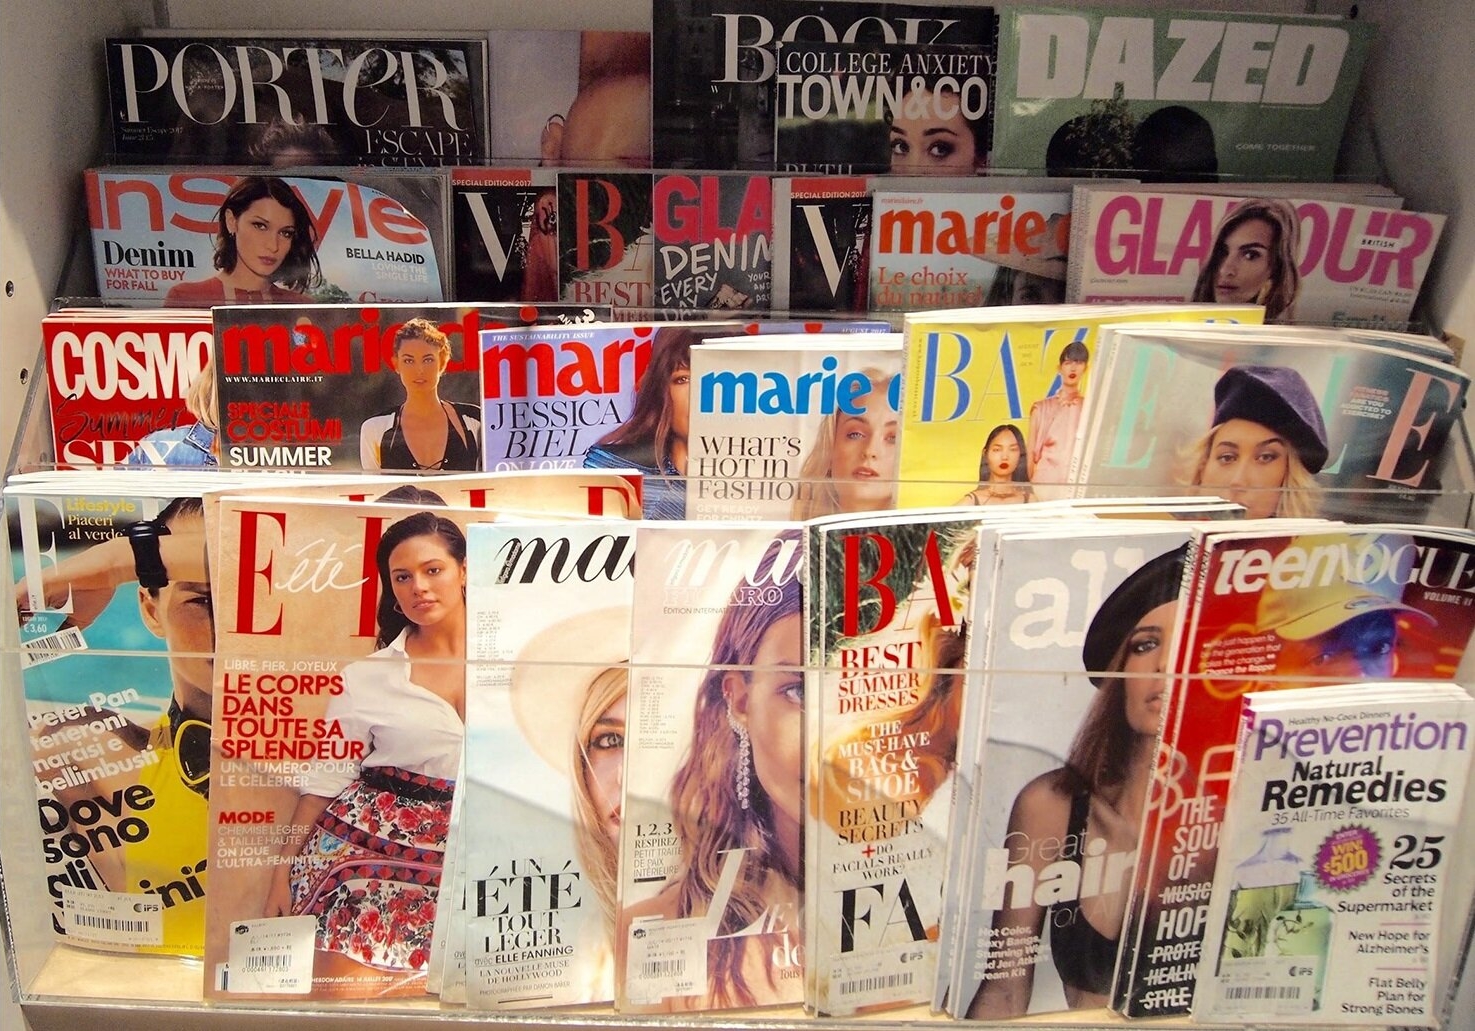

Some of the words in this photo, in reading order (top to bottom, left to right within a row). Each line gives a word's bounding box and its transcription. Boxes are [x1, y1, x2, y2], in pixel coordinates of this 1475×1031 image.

[786, 51, 892, 74] COLLEGE
[899, 53, 994, 76] ANXIETY
[1016, 13, 1350, 105] DAZED
[113, 42, 470, 131] PORTER
[777, 74, 987, 120] TOWN&CO
[364, 128, 473, 156] ESCAPE
[452, 179, 483, 187] SPECIAL
[484, 179, 514, 187] EDITION
[515, 179, 532, 187] 2017
[878, 195, 1047, 256] marie
[102, 240, 196, 269] Denim
[1095, 195, 1434, 290] GLAOUR
[1361, 239, 1396, 249] BRITISH
[345, 248, 384, 262] BELLA
[385, 250, 425, 265] HADID
[104, 267, 139, 281] WHAT
[139, 268, 158, 281] TO
[159, 268, 186, 282] BUY
[105, 279, 129, 291] FOR
[129, 280, 158, 292] FALL
[877, 266, 905, 285] Le
[911, 266, 968, 287] choix
[575, 280, 651, 302] BEST
[661, 272, 718, 306] EVERY
[493, 334, 506, 342] THE
[507, 332, 568, 341] SUSTAINABILITY
[571, 331, 596, 339] ISSUE
[225, 375, 324, 384] WWW.MARIECLAIRE.IT
[700, 356, 874, 416] marie
[227, 401, 311, 421] SPECIALE
[490, 397, 623, 431] JESSICA
[227, 418, 342, 445] COSTUMI
[504, 428, 589, 460] BIEL
[229, 446, 332, 467] SUMMER
[67, 513, 114, 527] Piaceri
[274, 538, 370, 593] été
[1214, 546, 1346, 595] teen
[22, 623, 48, 634] €3,60
[839, 641, 922, 680] BEST
[223, 673, 251, 694] LE
[256, 674, 345, 696] CORPS
[838, 672, 922, 698] SUMMER
[27, 703, 90, 729] Peter
[89, 687, 139, 711] Pan
[222, 695, 294, 717] DANS
[838, 689, 920, 715] DRESSES
[30, 712, 128, 751] teneroni
[221, 717, 308, 739] TOUTE
[312, 719, 344, 739] SA
[868, 720, 902, 739] THE
[1288, 717, 1321, 727] Healthy
[1359, 711, 1392, 720] Dinners
[839, 731, 931, 759] MUST-HAVE
[1253, 712, 1468, 761] Prevention
[33, 743, 111, 773] narcisi
[109, 737, 123, 751] e
[220, 739, 365, 761] SPLENDEUR
[36, 744, 160, 795] bellimbusti
[848, 752, 899, 779] BAG
[901, 749, 921, 771] &
[1291, 755, 1383, 783] Natural
[847, 770, 921, 804] SHOE
[1261, 770, 1448, 812] Remedies
[37, 784, 156, 835] Dove
[218, 810, 275, 825] MODE
[839, 799, 922, 829] BEAUTY
[1179, 794, 1219, 826] THE
[1289, 808, 1345, 824] All-Time
[1348, 806, 1410, 820] Favorites
[42, 816, 150, 864] sono
[837, 816, 924, 846] SECRETS
[217, 846, 236, 857] ON
[239, 846, 270, 857] JOUE
[1003, 828, 1090, 864] Great
[1389, 834, 1446, 870] 25
[833, 855, 885, 874] FACIALS
[888, 846, 933, 864] REALLY
[862, 863, 906, 881] WORK?
[1167, 851, 1200, 881] OF
[1322, 852, 1369, 876] $500
[982, 837, 1140, 912] hair
[1383, 872, 1437, 885] Secrets
[472, 859, 582, 919] ÉTÉ
[1161, 882, 1213, 905] MUSIC
[1392, 885, 1408, 897] of
[1410, 885, 1435, 897] the
[1337, 900, 1434, 915] Supermarket
[492, 911, 559, 933] TOUT
[1348, 930, 1374, 941] New
[1377, 930, 1410, 943] Hope
[1413, 931, 1430, 941] for
[1357, 943, 1430, 954] Alzheimer's
[496, 953, 519, 964] ELLE
[522, 945, 574, 961] FANNING
[1368, 977, 1393, 988] Flat
[1396, 976, 1426, 990] Belly
[1143, 986, 1191, 1010] STYLE
[1340, 1002, 1384, 1016] Strong
[1385, 1003, 1424, 1014] Bones
[1377, 991, 1404, 1002] Plan
[1408, 991, 1426, 1001] for
